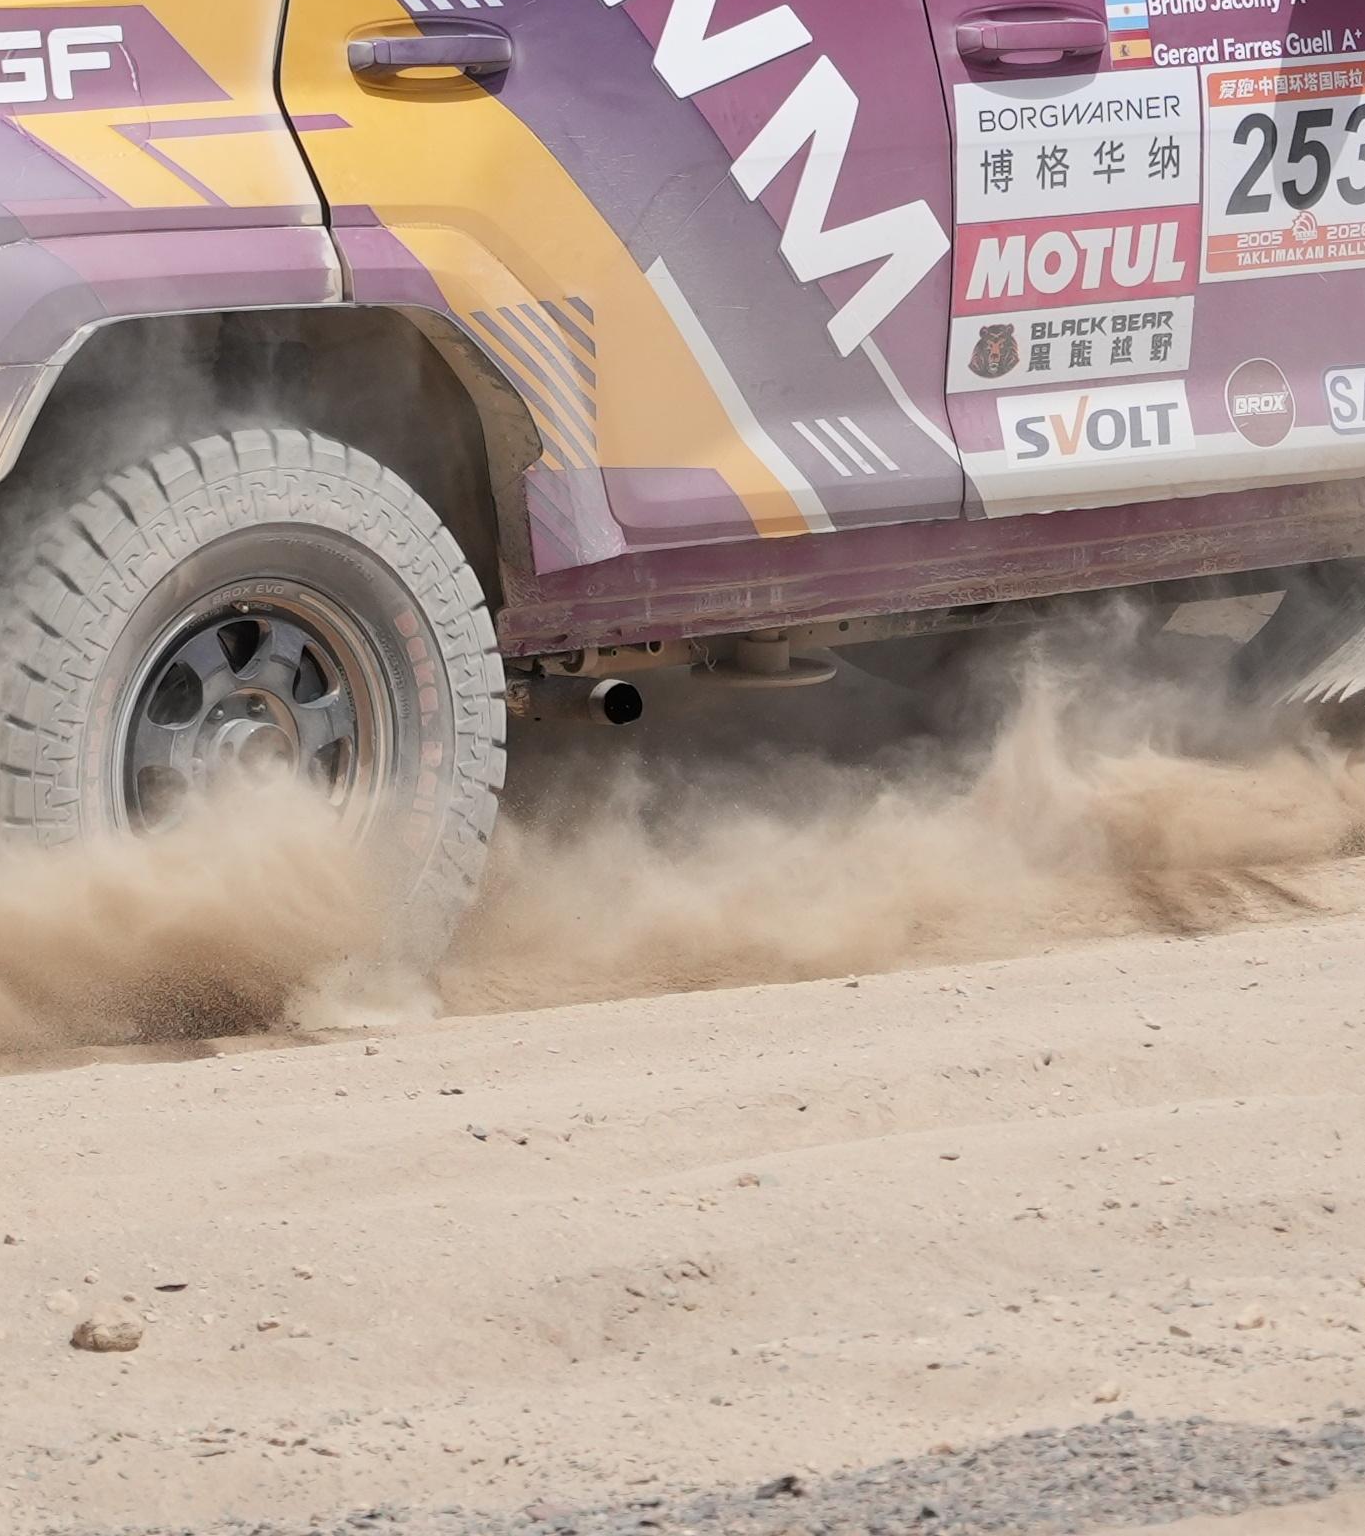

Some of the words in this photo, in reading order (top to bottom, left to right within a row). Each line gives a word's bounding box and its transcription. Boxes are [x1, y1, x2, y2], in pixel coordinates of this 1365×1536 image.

[1153, 38, 1219, 66] Gerard
[1223, 37, 1283, 61] Farres
[1285, 29, 1333, 56] Guell
[979, 95, 1181, 133] BORGWARNER
[980, 135, 1182, 195] 博格华纳
[1237, 230, 1283, 248] 2005
[965, 222, 1186, 301] MOTUL
[1237, 246, 1324, 266] TAKLIMAKAN
[1030, 315, 1108, 340] BLACK
[1111, 310, 1175, 333] BEAR
[1235, 391, 1289, 416] BROX
[1014, 395, 1179, 461] SVOLT
[255, 583, 285, 595] EVO
